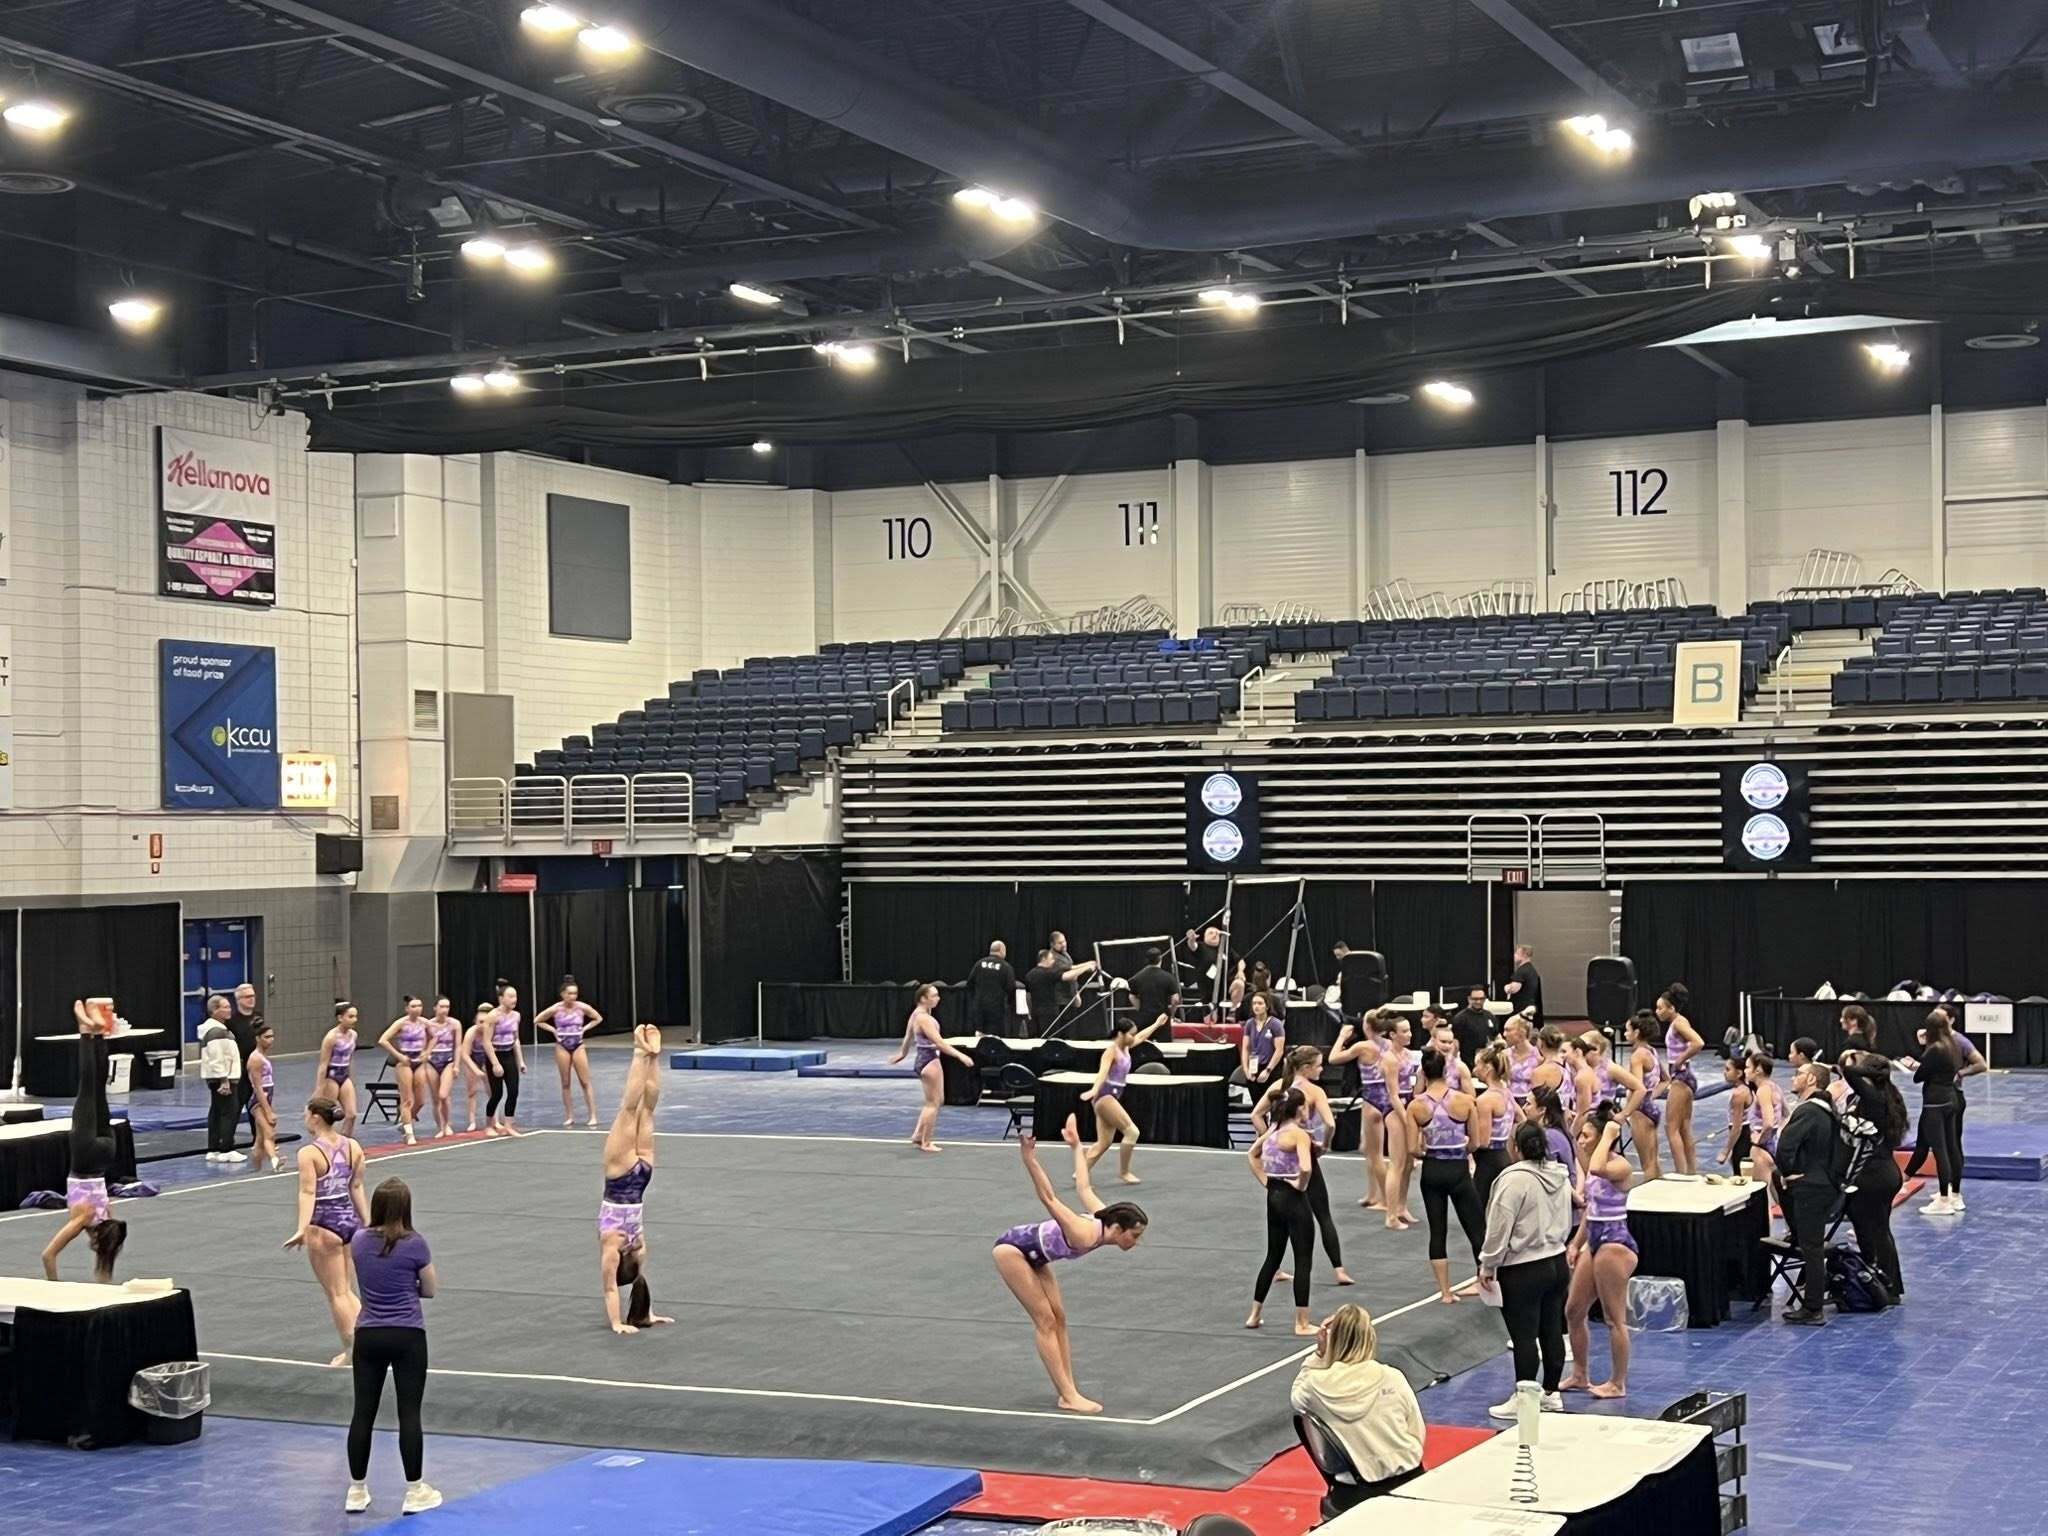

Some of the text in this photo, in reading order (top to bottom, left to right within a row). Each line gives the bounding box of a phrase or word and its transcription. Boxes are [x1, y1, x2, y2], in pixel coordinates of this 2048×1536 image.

[168, 450, 270, 495] Kellanova
[1609, 468, 1668, 517] 112
[882, 517, 932, 560] 110
[1118, 501, 1158, 546] 111
[173, 655, 198, 665] proud
[173, 667, 182, 677] of
[183, 668, 202, 678] food
[1691, 663, 1724, 703] B
